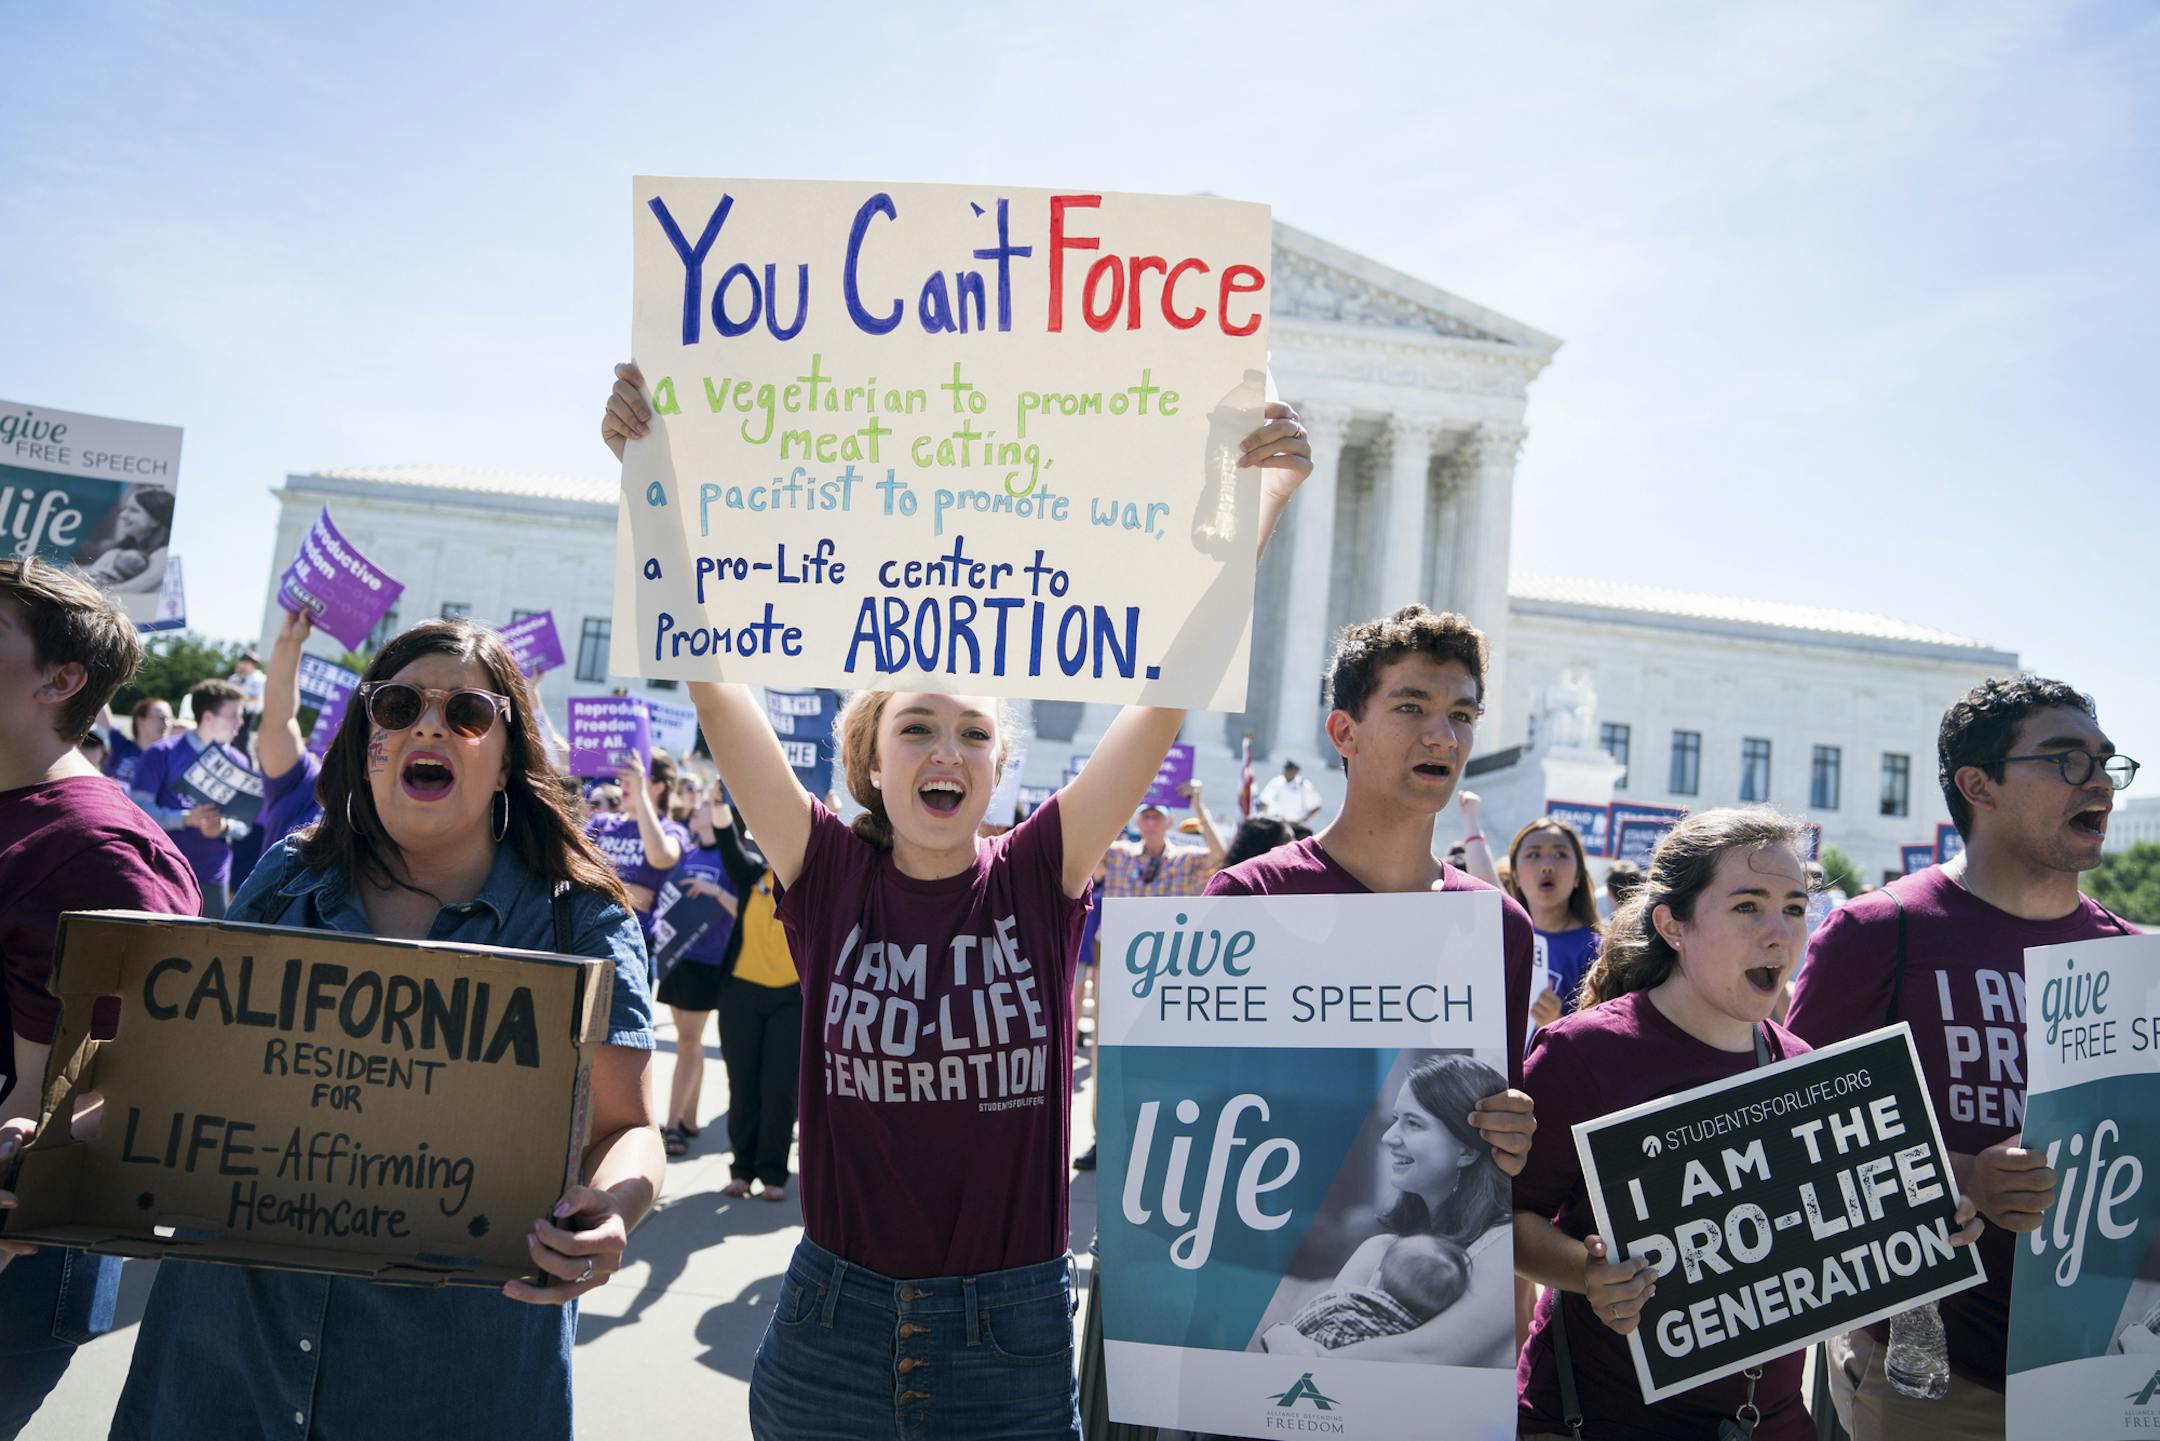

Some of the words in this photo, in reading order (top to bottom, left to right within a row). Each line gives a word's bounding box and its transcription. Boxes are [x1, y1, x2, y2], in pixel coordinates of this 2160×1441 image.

[648, 193, 808, 345] You
[1047, 195, 1265, 336] Force
[0, 411, 67, 444] give
[653, 376, 682, 415] a
[703, 353, 926, 444] vegetarian
[940, 362, 986, 414] to
[15, 440, 71, 465] FREE
[81, 450, 168, 476] SPEECH
[780, 416, 892, 463] meat
[911, 419, 1054, 497] eating,
[646, 481, 667, 506] a
[700, 465, 863, 536] pacifist
[876, 468, 917, 516] to
[1091, 497, 1169, 540] war,
[643, 558, 662, 580] a
[696, 538, 846, 604] pro-Life
[878, 535, 1013, 589] center
[1023, 550, 1069, 597] to
[844, 595, 1161, 679] ABORTION.
[786, 745, 812, 763] HE
[834, 923, 862, 976] I
[853, 940, 928, 1000] AM
[1125, 913, 1256, 998] give
[1935, 969, 1955, 1021] I
[143, 955, 540, 1068] CALIFORNIA
[823, 975, 1048, 1058] PRO-LIFE
[1160, 985, 1267, 1022] FREE
[1291, 984, 1474, 1023] SPEECH
[2042, 959, 2110, 1045] give
[2061, 1020, 2117, 1065] FREE
[263, 1038, 447, 1095] RESIDENT
[312, 1083, 362, 1113] FOR
[1665, 1068, 1872, 1151] STUDENTSFORLIFE.ORG
[1122, 1093, 1301, 1270] life
[1628, 1178, 1650, 1222] I
[1681, 1139, 1771, 1208] AM
[1791, 1094, 1905, 1164] THE
[1626, 1142, 1944, 1296] PRO-LIFE
[1656, 1217, 1956, 1359] GENERATION
[1266, 1417, 1344, 1433] FREEDOM
